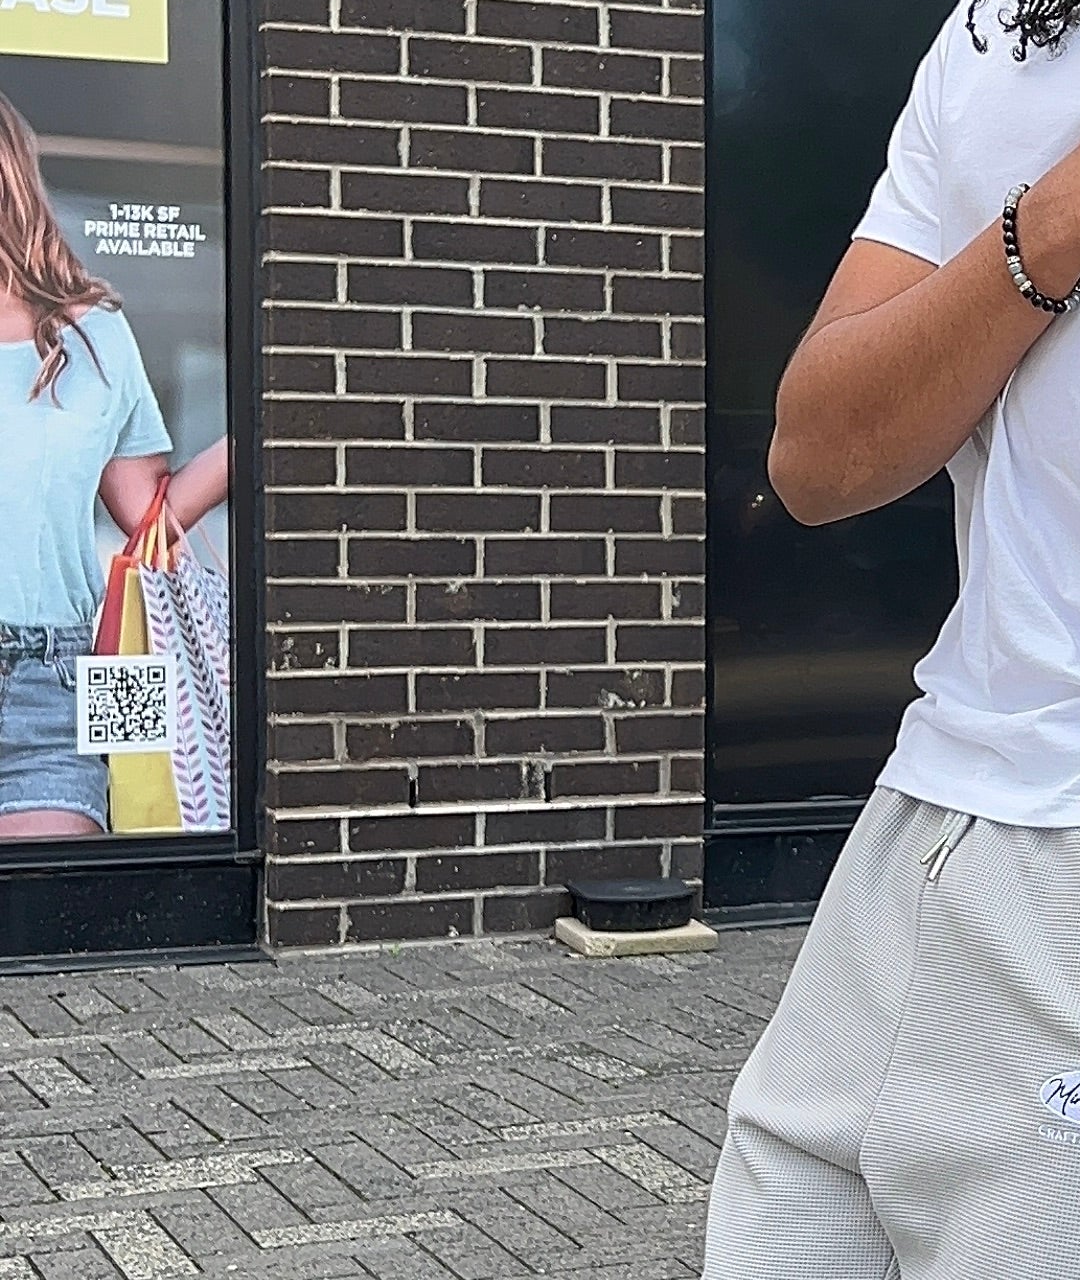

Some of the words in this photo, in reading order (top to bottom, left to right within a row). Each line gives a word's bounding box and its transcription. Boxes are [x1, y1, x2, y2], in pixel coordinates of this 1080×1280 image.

[109, 203, 155, 221] 1-13K
[157, 206, 181, 222] SF
[84, 220, 141, 238] PRIME
[143, 222, 206, 241] RETAIL
[95, 238, 195, 257] AVAILABLE
